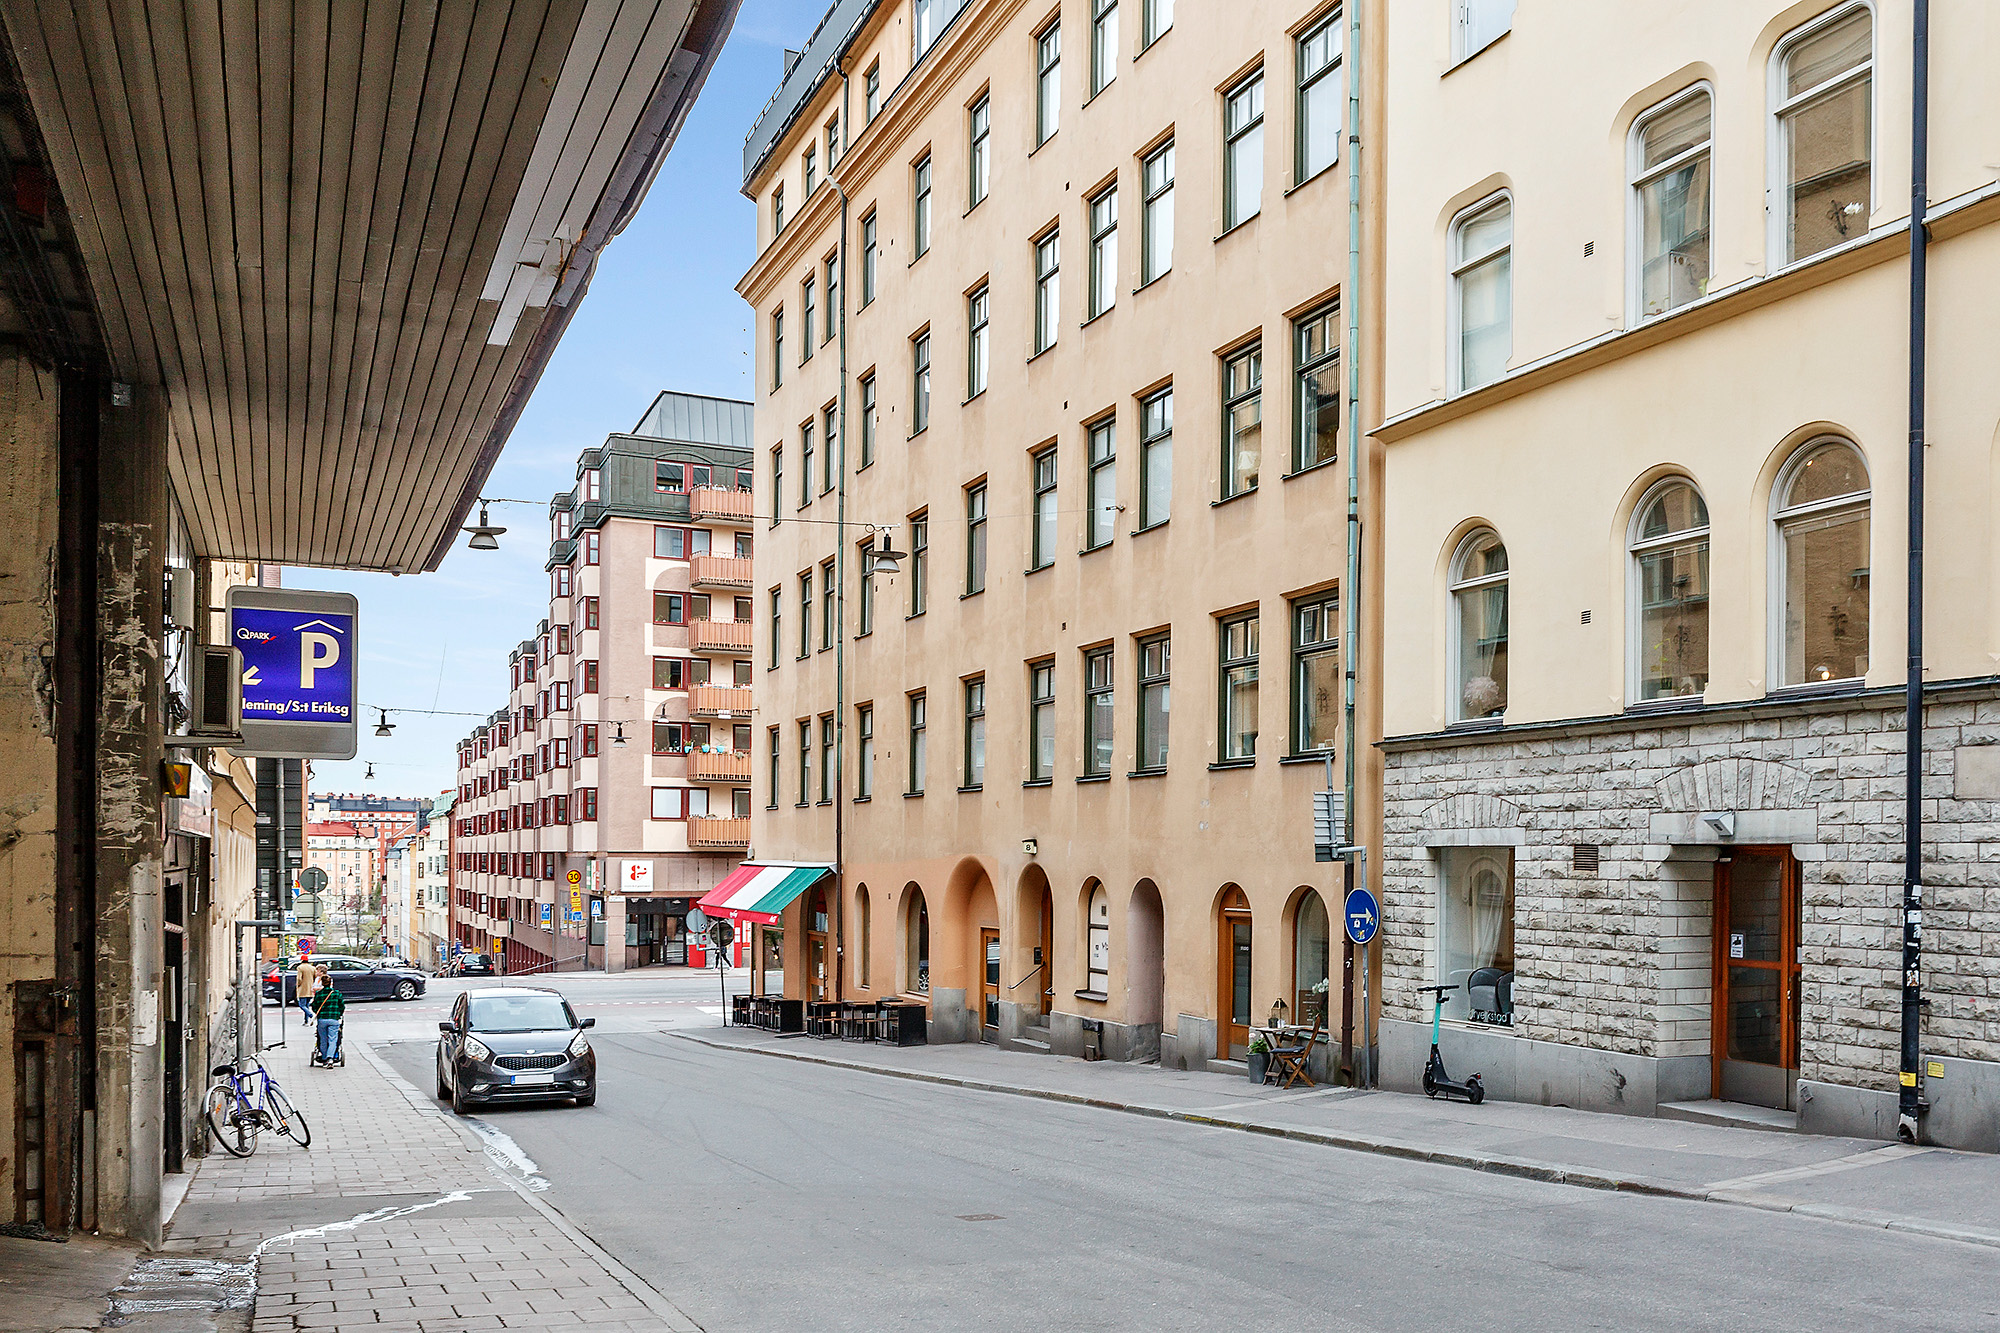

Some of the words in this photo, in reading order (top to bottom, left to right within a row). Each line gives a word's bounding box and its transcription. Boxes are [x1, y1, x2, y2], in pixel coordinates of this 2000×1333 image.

[300, 631, 340, 689] P
[242, 697, 309, 714] leming/S:t
[311, 702, 349, 717] Eriksg
